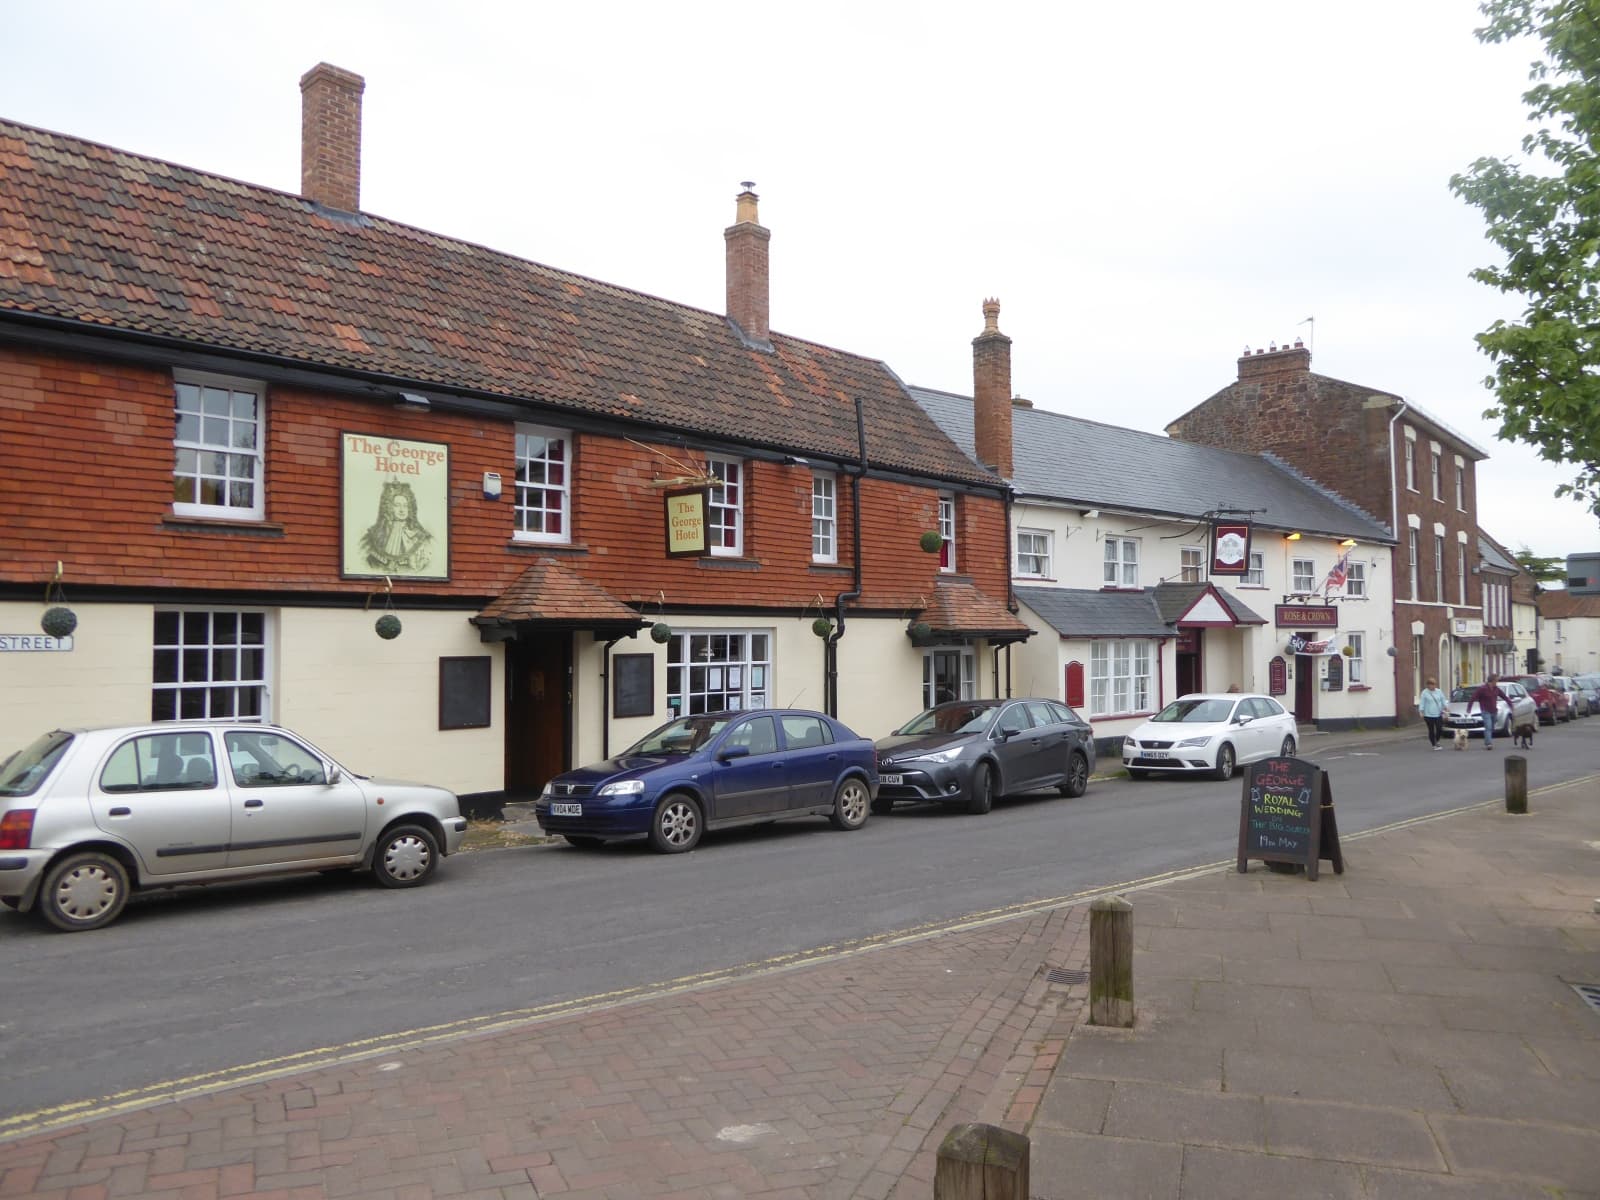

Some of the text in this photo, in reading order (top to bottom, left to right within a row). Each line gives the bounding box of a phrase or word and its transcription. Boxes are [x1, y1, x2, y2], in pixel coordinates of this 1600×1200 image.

[347, 437, 444, 466] The George
[375, 456, 420, 475] Hotel
[677, 502, 695, 513] The
[671, 516, 702, 528] George
[675, 528, 699, 541] Hotel
[1284, 611, 1330, 621] ROSE & CROWN
[1268, 761, 1290, 772] THE
[1256, 774, 1305, 785] GEORGE
[1264, 793, 1298, 807] ROYAL
[1254, 805, 1304, 818] WEDDING
